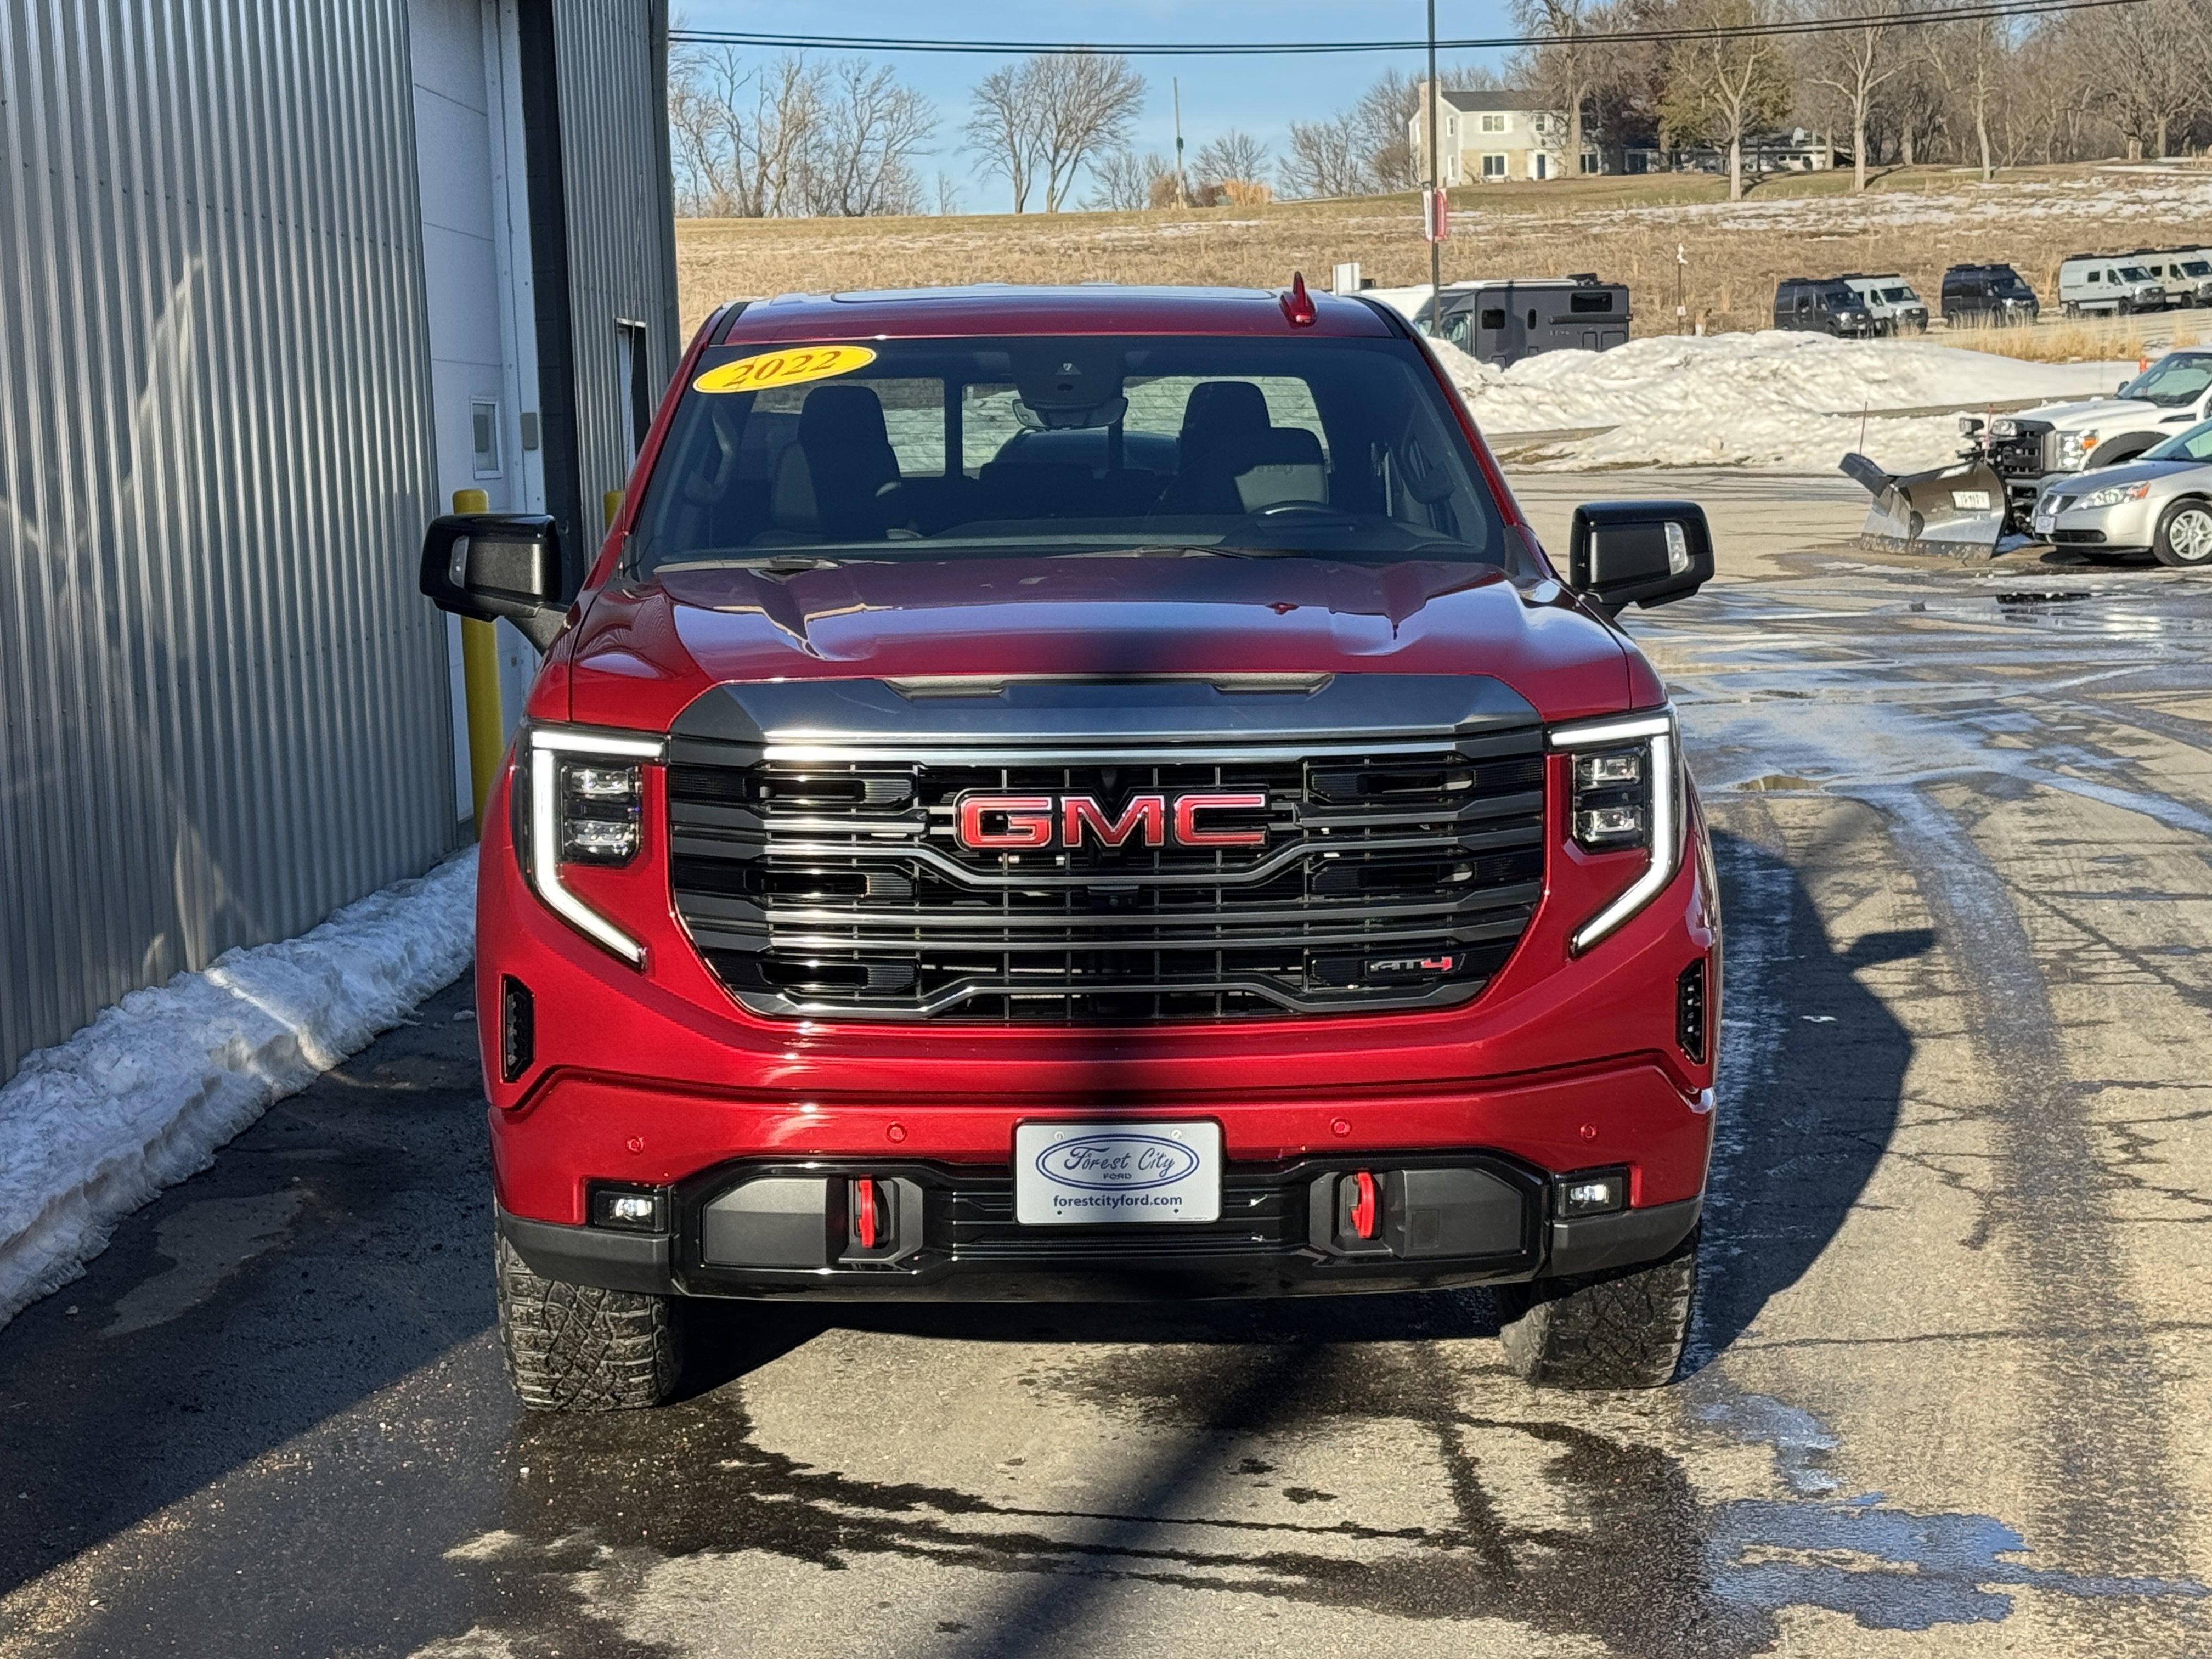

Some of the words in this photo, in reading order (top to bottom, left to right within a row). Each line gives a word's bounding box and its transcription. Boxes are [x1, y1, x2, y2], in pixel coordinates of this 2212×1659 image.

[721, 350, 842, 387] 2022
[960, 793, 1267, 848] GMC
[1369, 956, 1453, 972] AT4
[1063, 1146, 1131, 1171] Forest
[1137, 1147, 1176, 1178] City
[1053, 1194, 1183, 1210] forestcityford.com
